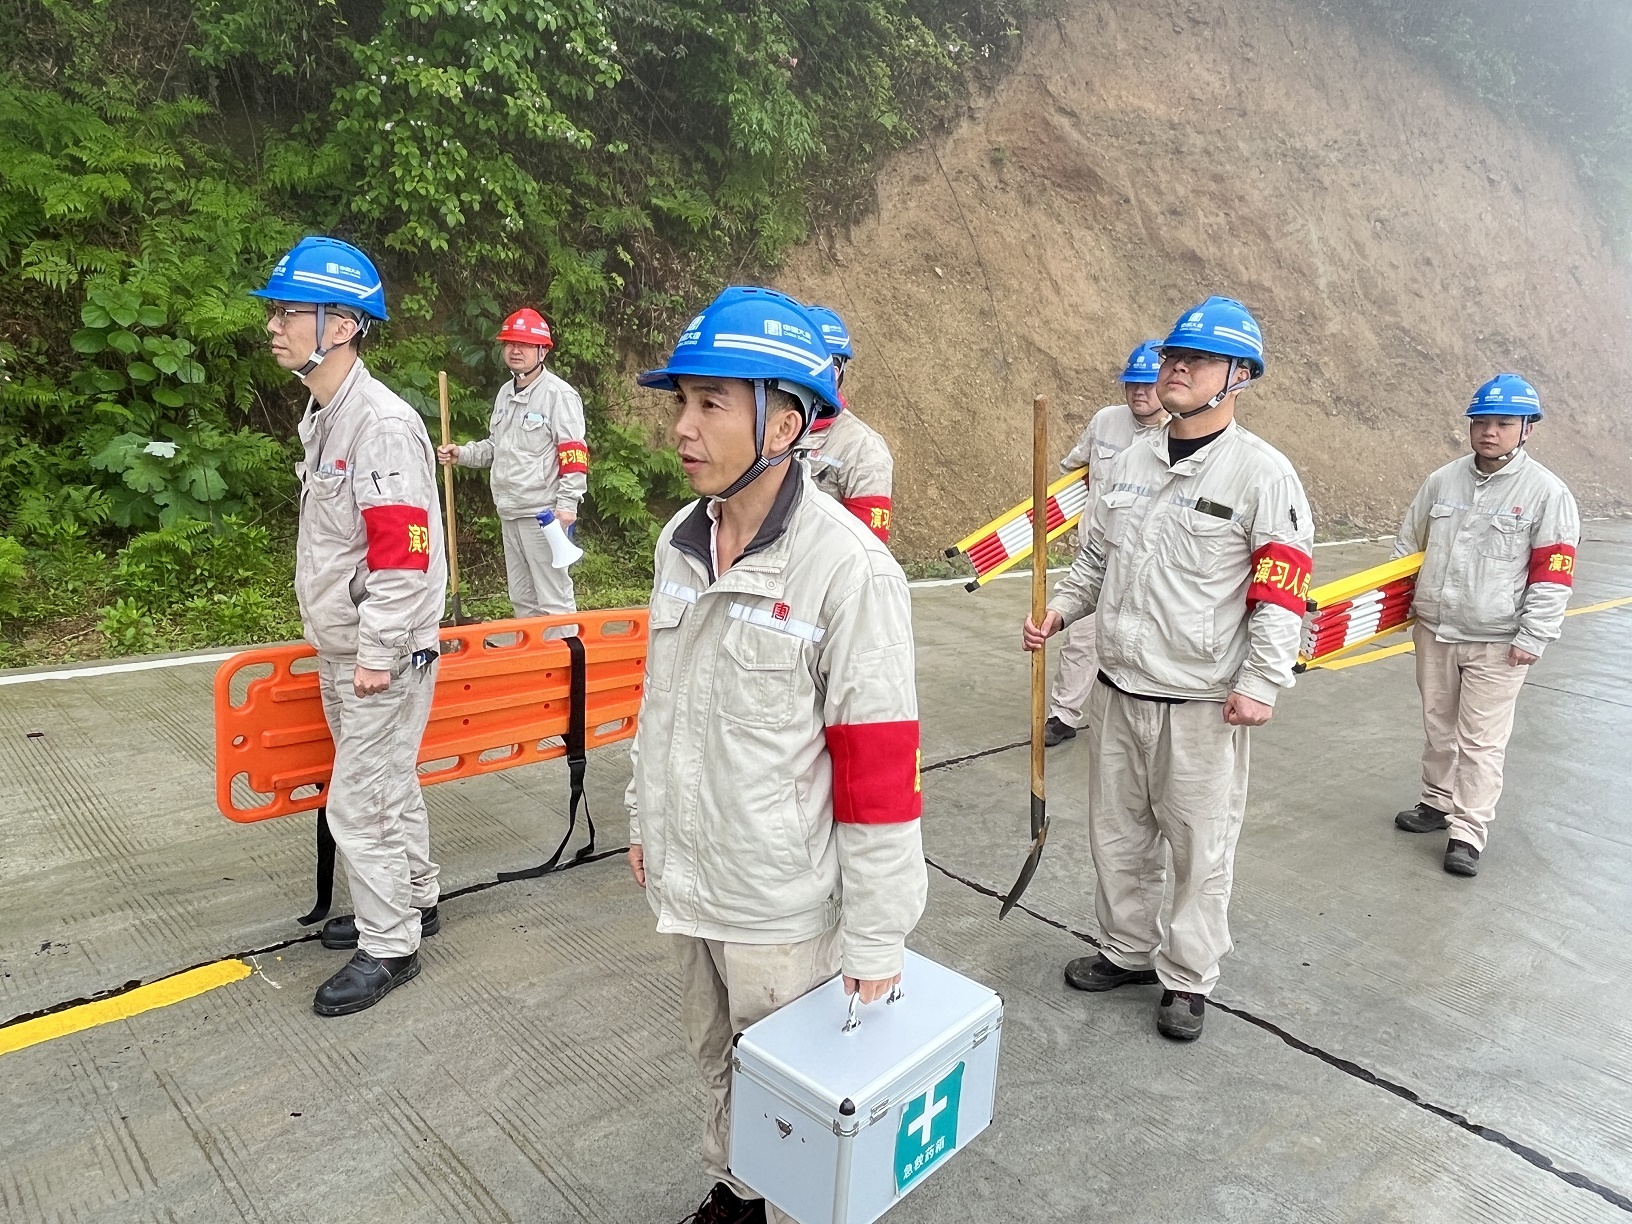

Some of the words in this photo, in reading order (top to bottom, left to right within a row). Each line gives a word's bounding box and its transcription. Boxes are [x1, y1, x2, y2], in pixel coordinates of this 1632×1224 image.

[1253, 556, 1311, 602] 演习人员
[903, 1135, 946, 1181] 急救药箱
